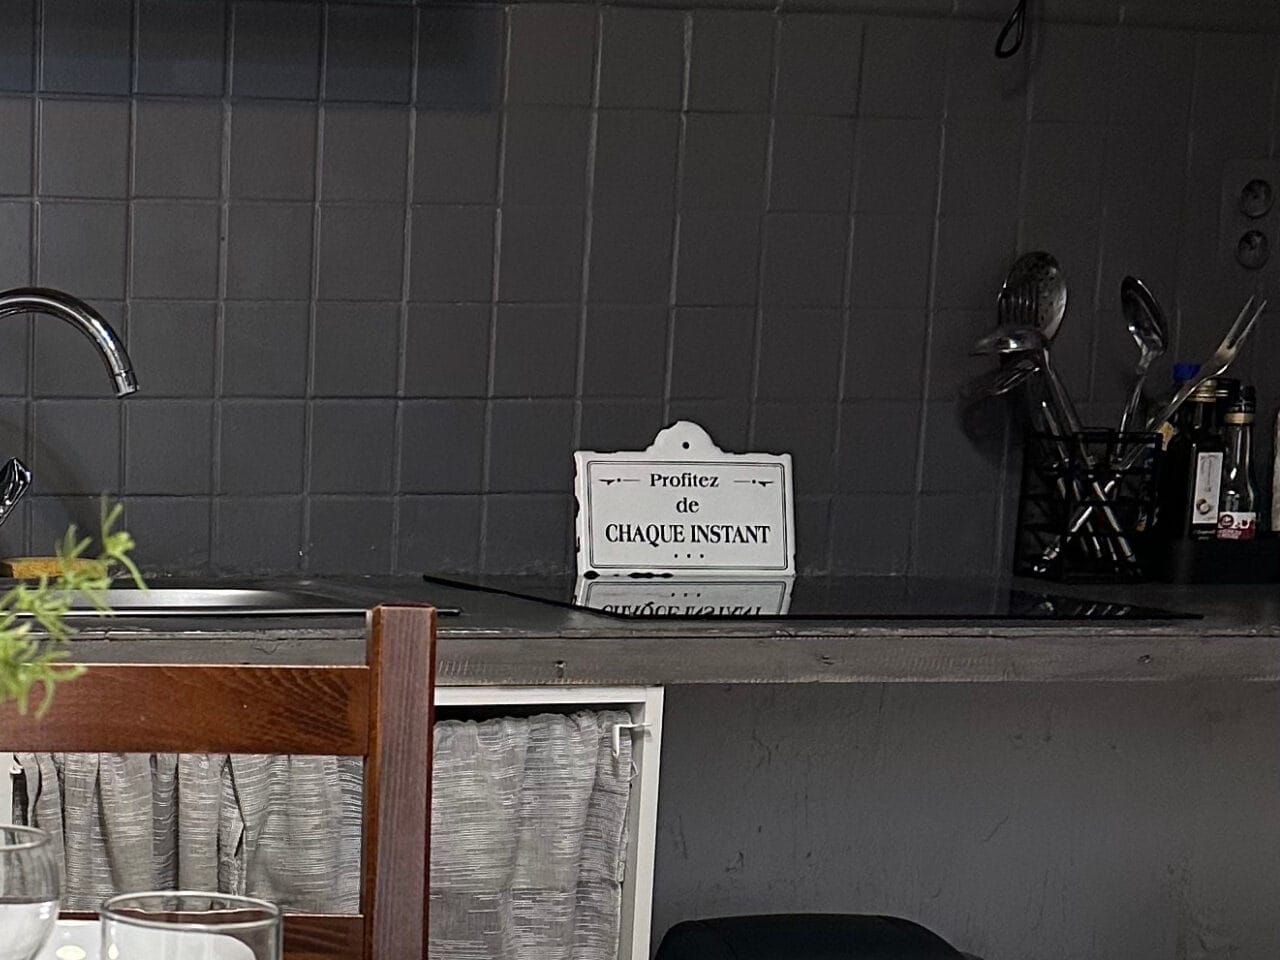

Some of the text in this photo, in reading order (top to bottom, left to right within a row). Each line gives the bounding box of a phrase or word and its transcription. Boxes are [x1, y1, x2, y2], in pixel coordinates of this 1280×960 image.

[650, 473, 719, 488] Profitez
[676, 497, 700, 513] de
[605, 523, 771, 547] CHAQUE INSTANT
